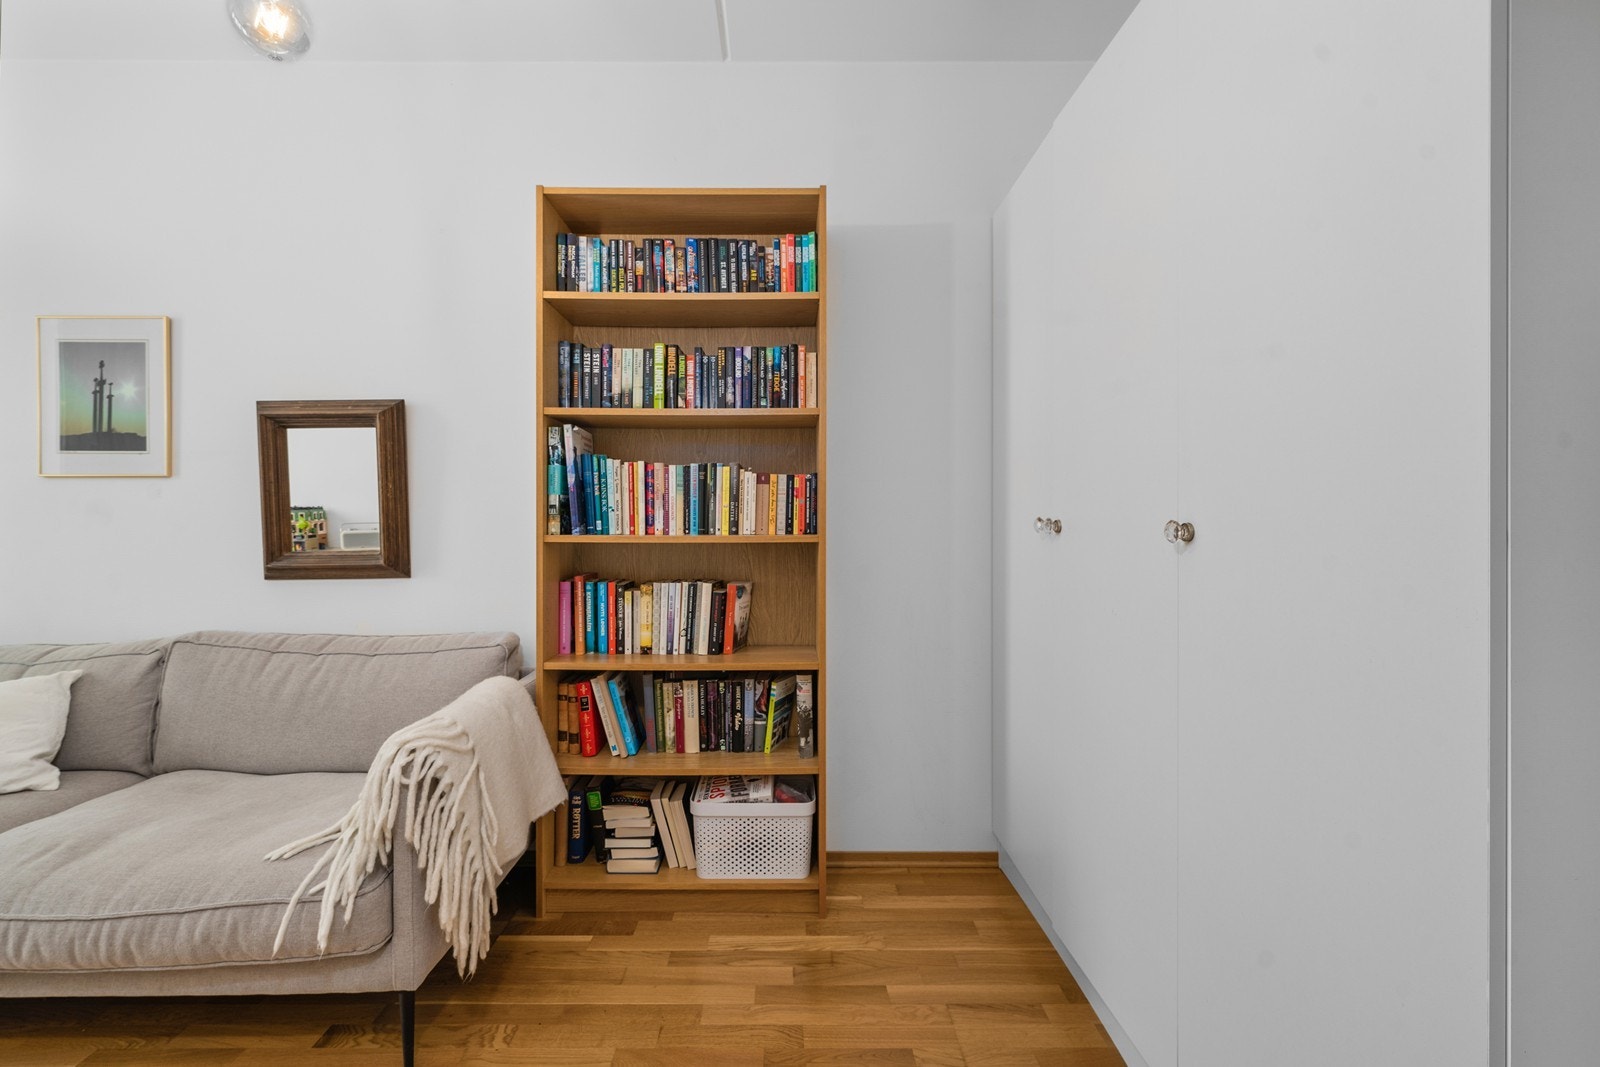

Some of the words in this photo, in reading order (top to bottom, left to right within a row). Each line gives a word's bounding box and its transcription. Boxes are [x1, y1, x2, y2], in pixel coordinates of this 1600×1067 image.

[655, 345, 663, 363] UNNI
[655, 366, 663, 395] LINDELL
[572, 808, 581, 839] RØTTER
